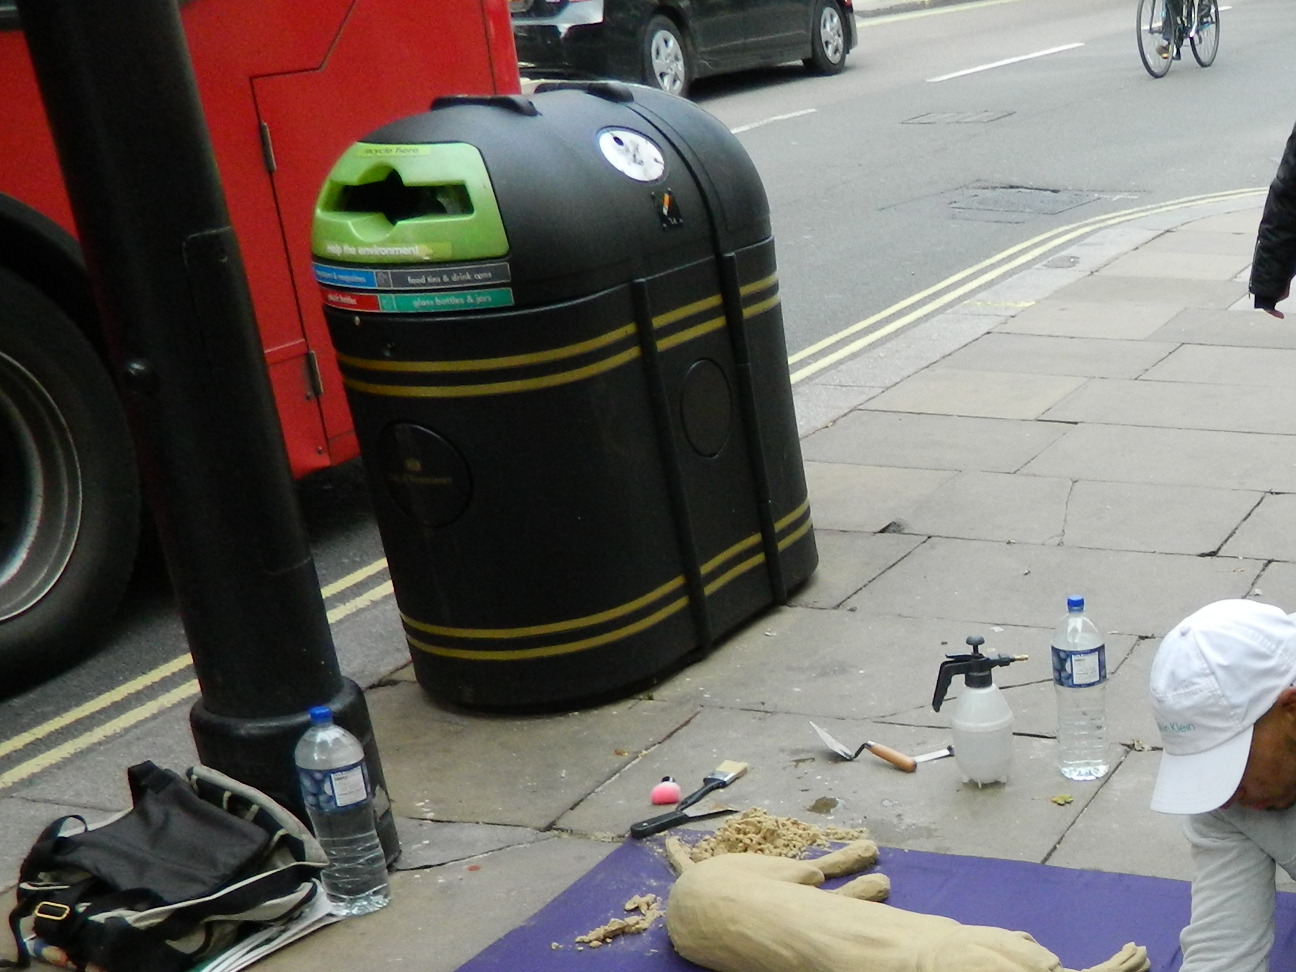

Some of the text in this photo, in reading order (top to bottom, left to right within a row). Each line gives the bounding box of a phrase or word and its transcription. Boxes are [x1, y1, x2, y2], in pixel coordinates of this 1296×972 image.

[395, 147, 419, 155] here
[407, 275, 426, 285] food
[427, 274, 441, 283] tins
[442, 273, 450, 282] &
[451, 271, 472, 281] drink
[413, 294, 493, 309] glass bottles & jars
[1169, 722, 1196, 733] Klein
